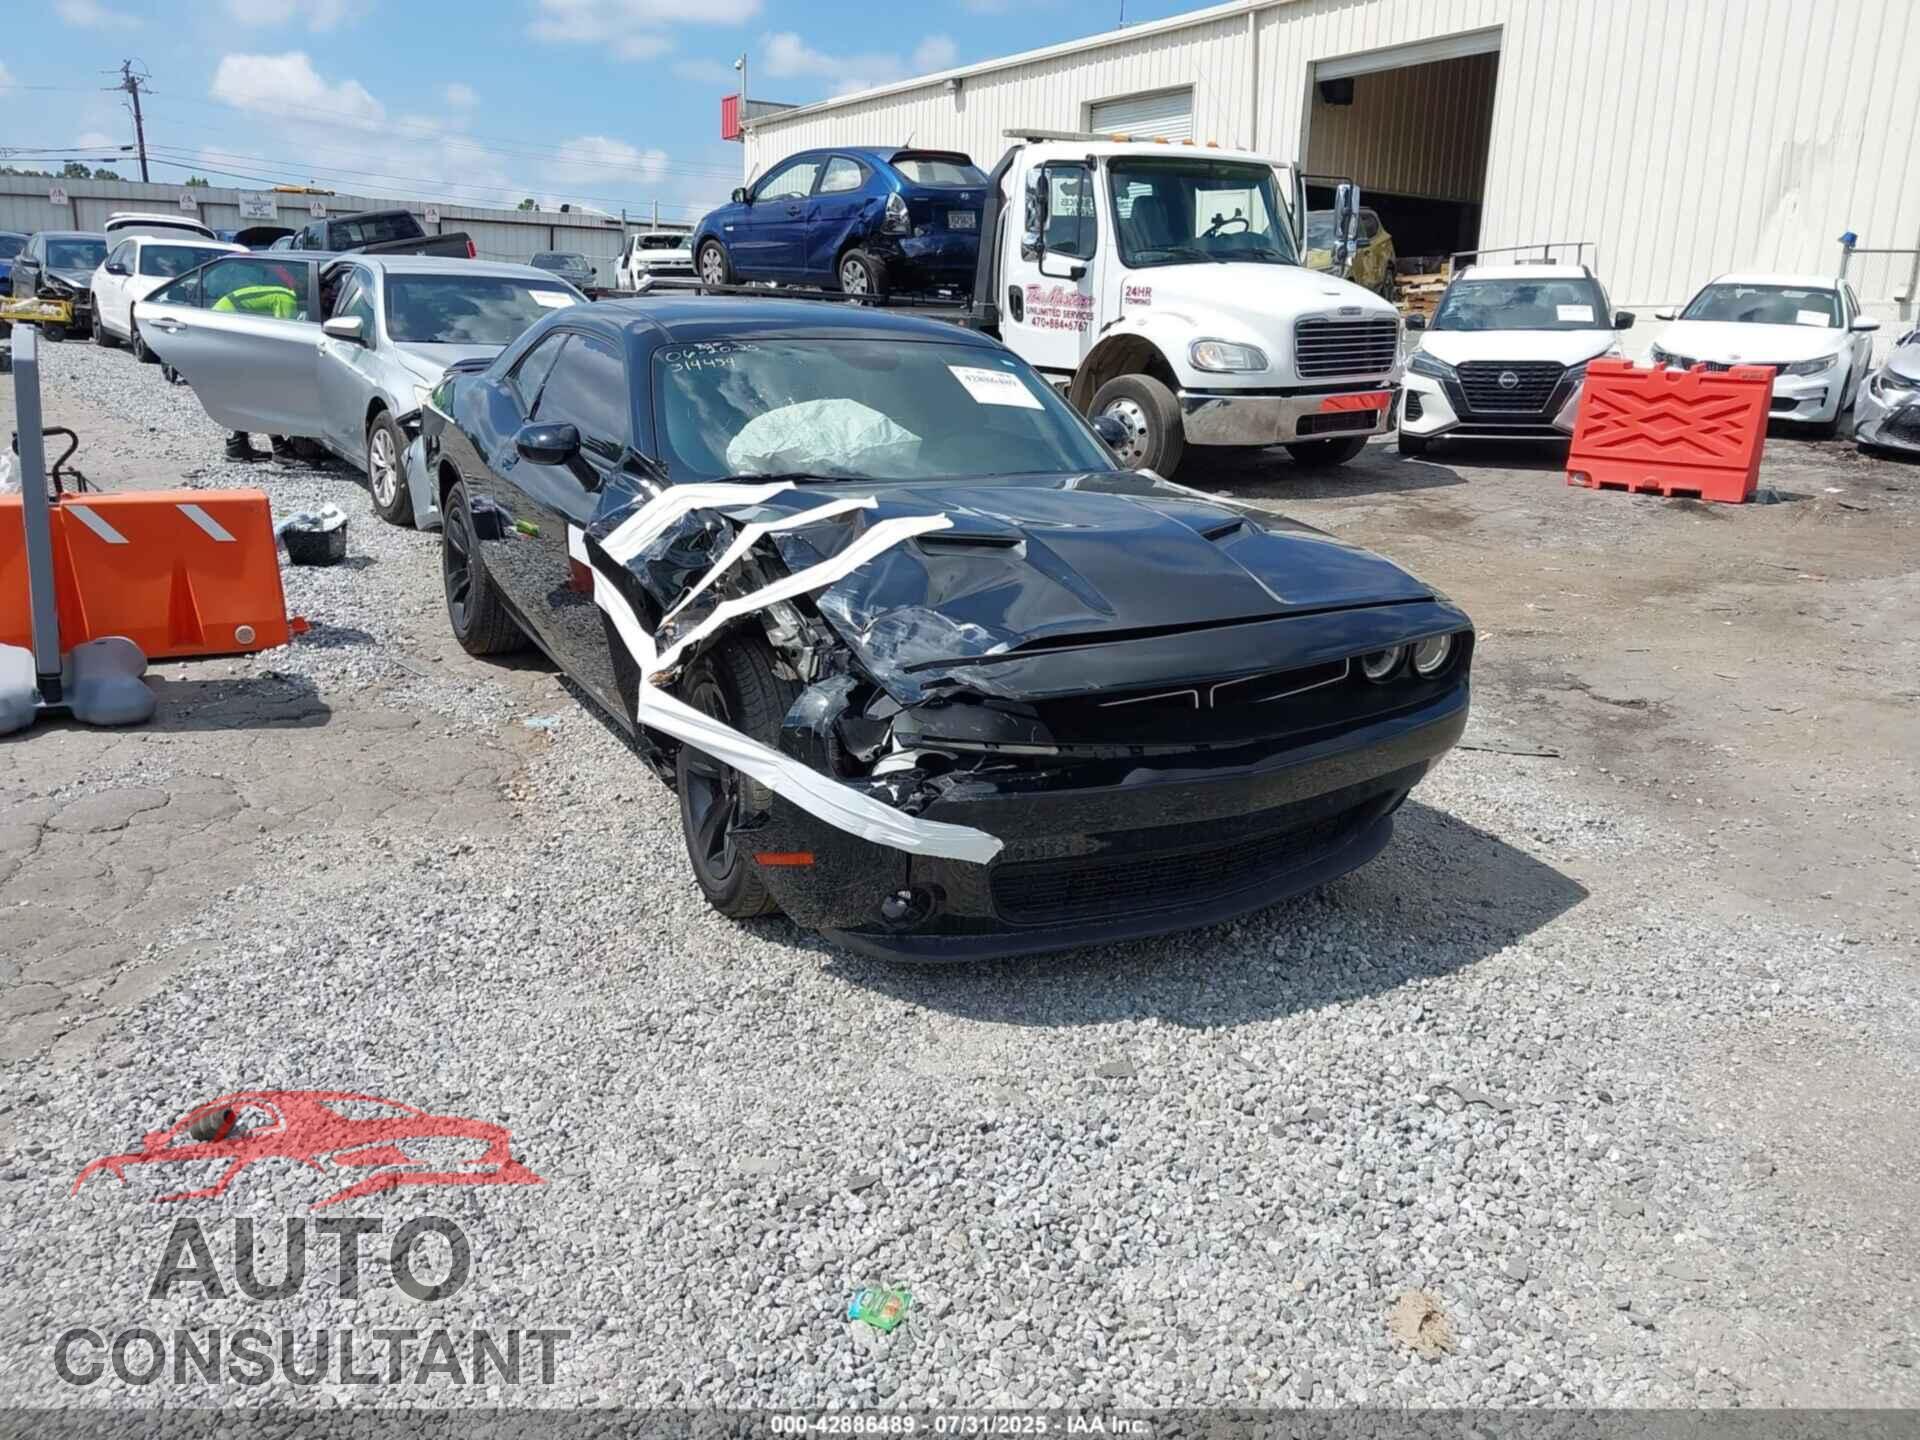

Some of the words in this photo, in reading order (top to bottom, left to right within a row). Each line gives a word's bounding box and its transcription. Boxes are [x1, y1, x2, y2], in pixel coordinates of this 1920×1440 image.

[1125, 286, 1152, 297] 24HR
[1025, 305, 1061, 318] UNLIMITED
[1063, 310, 1094, 321] SERVICES
